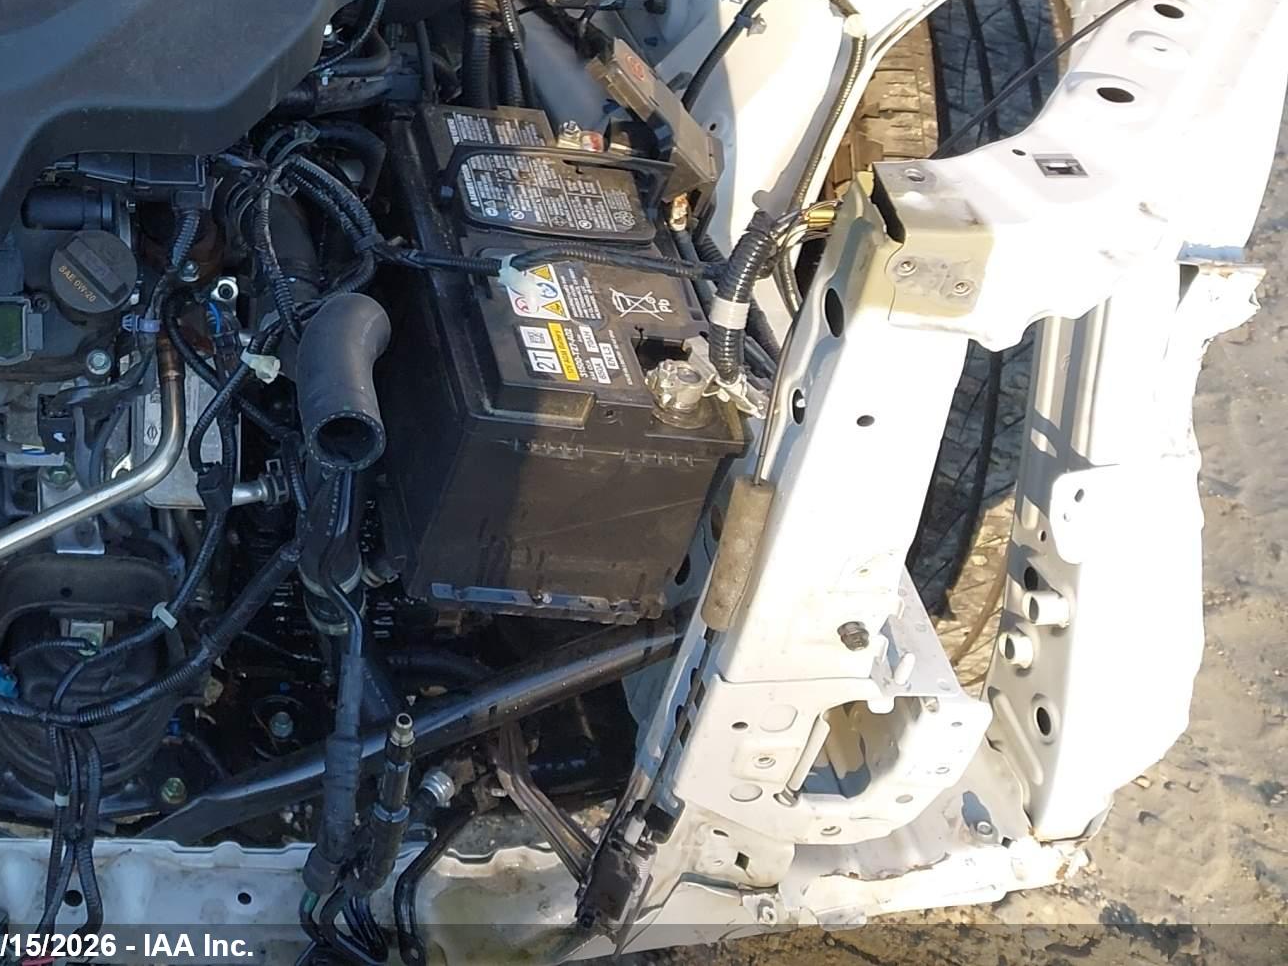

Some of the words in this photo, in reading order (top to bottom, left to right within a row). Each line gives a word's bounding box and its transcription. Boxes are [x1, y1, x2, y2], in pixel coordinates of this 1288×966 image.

[58, 265, 73, 282] SAE
[73, 277, 97, 303] 0W-20
[657, 298, 674, 314] Pb
[536, 352, 557, 372] 2T
